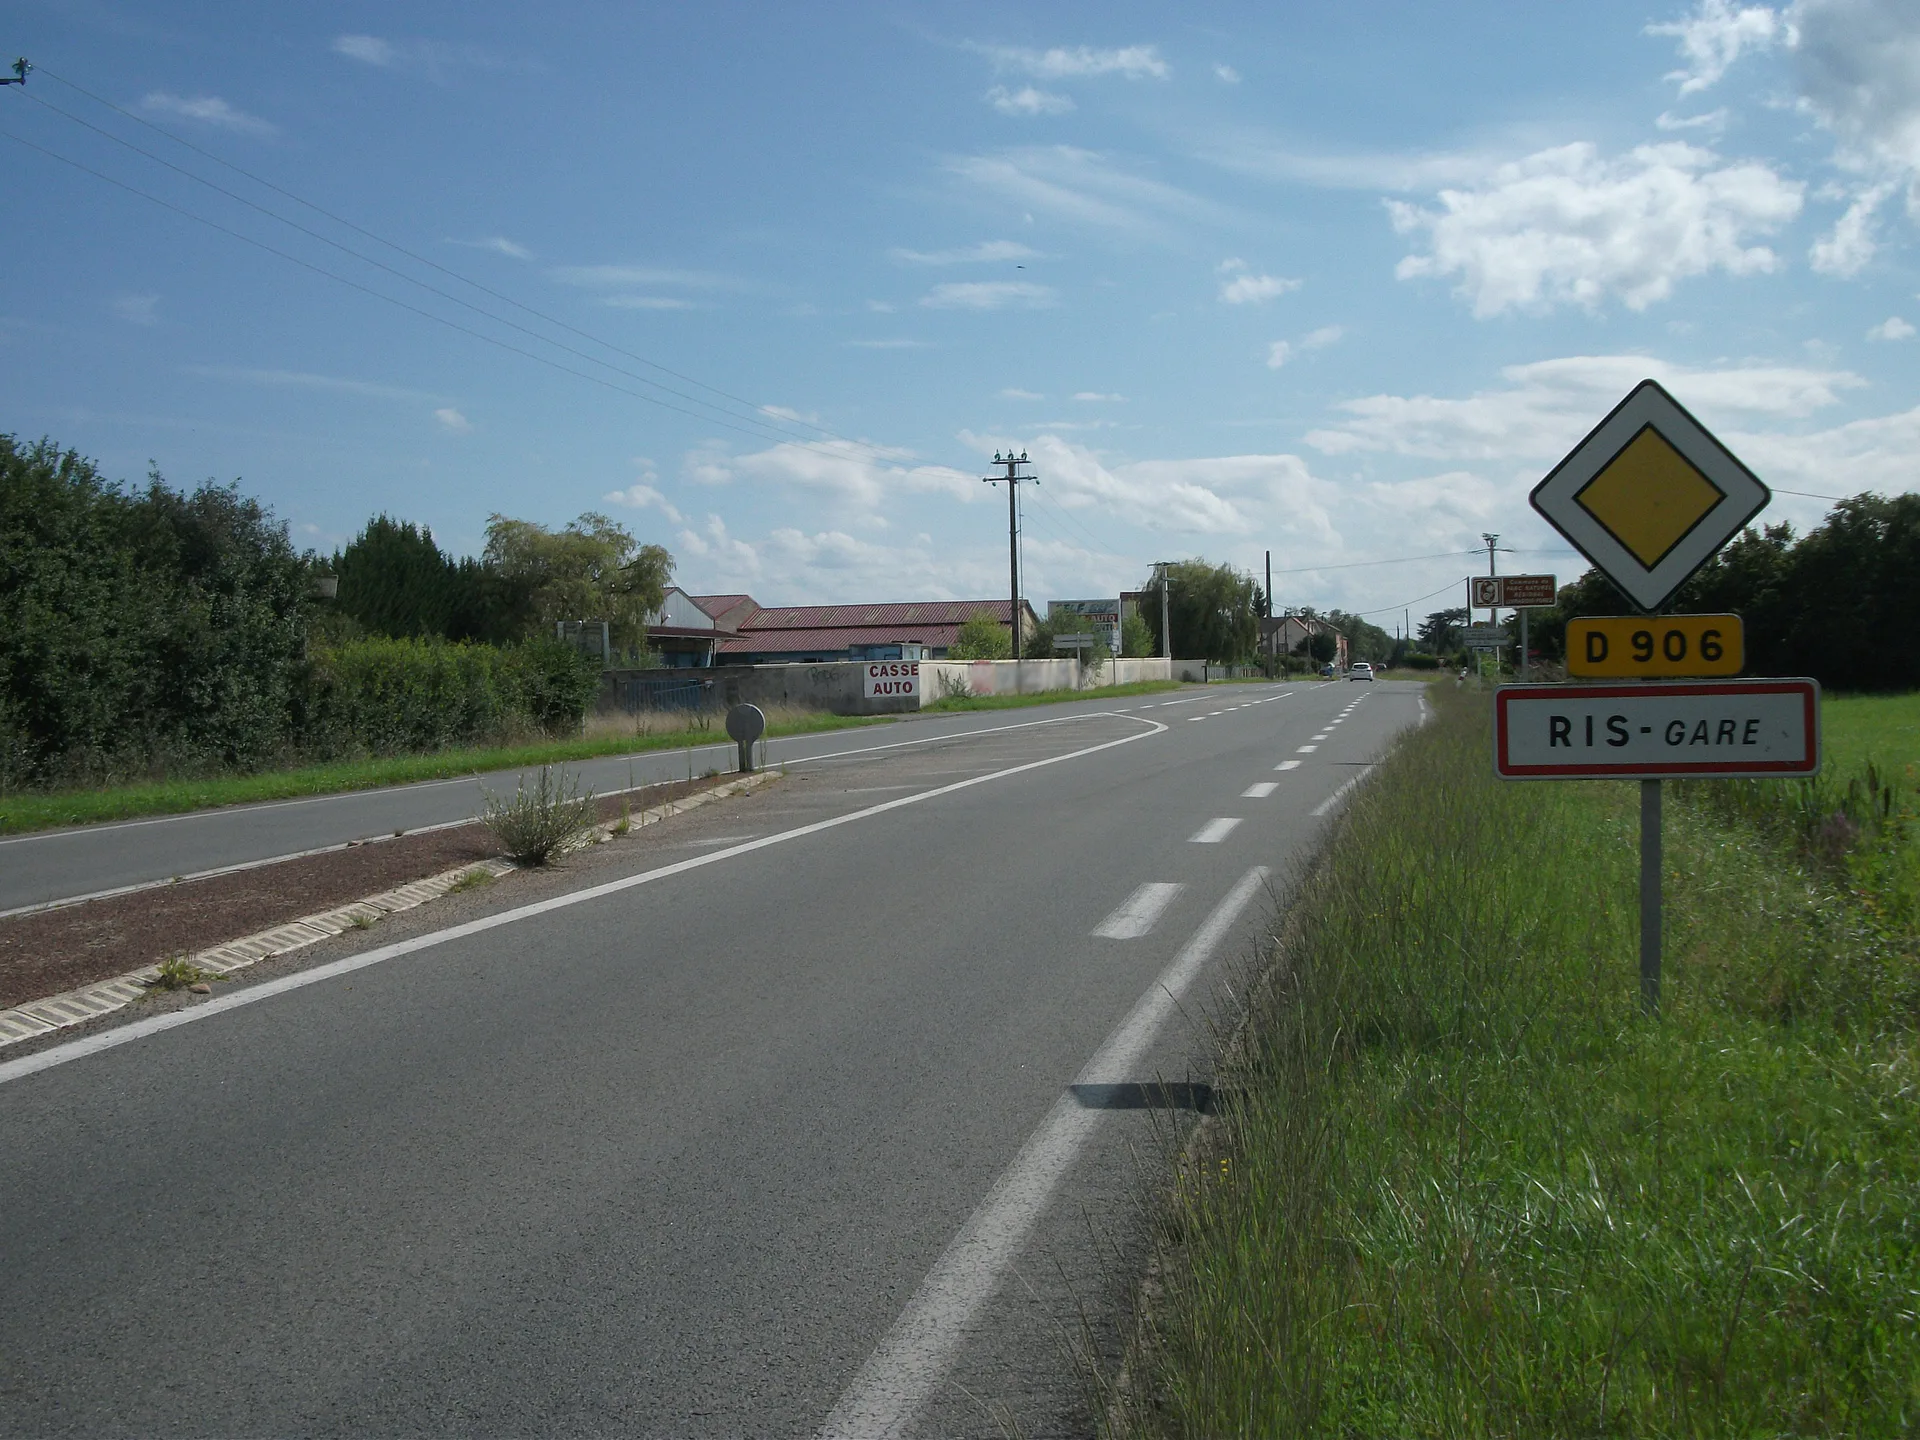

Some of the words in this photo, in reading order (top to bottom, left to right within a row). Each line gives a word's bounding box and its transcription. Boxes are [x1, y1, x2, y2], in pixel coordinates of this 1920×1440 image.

[1586, 631, 1608, 663] D
[1631, 630, 1723, 662] 906
[869, 664, 919, 678] CASSE
[873, 681, 913, 695] AUTO
